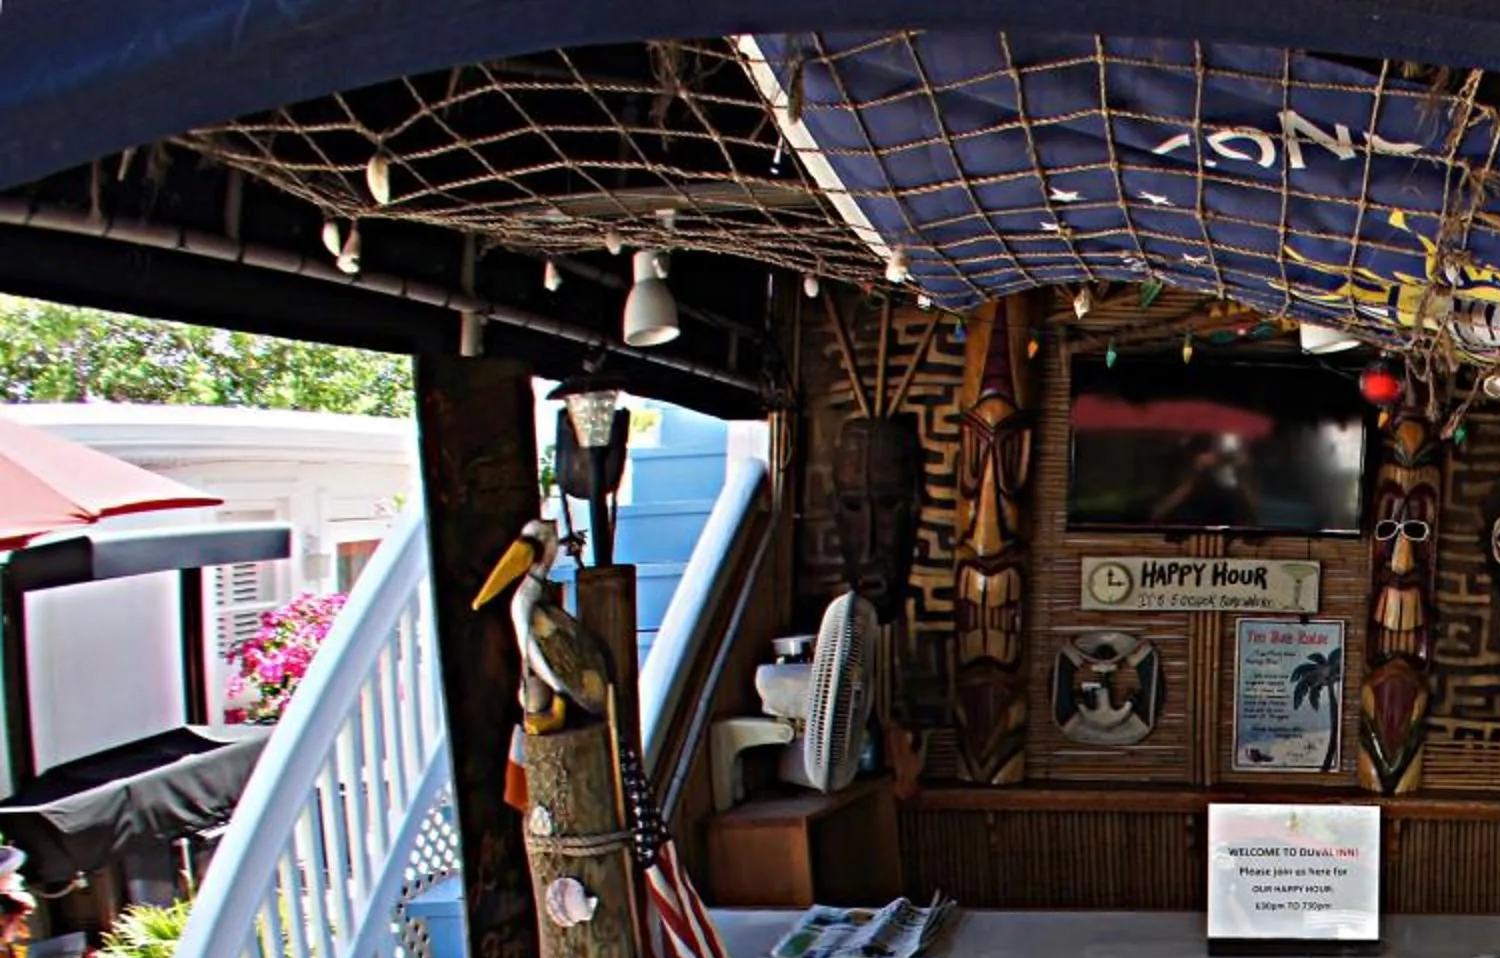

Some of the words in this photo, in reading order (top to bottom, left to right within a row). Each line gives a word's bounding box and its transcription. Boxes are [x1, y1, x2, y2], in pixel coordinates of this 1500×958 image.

[1140, 560, 1206, 588] HAPPY
[1212, 561, 1268, 590] HOUR
[1228, 848, 1280, 857] WELCOME
[1284, 848, 1296, 857] TO
[1300, 848, 1333, 857] DUVAL
[1336, 848, 1359, 857] INN!
[1239, 867, 1271, 876] Please
[1272, 867, 1293, 878] join
[1308, 867, 1332, 876] here
[1333, 867, 1347, 876] for
[1252, 885, 1272, 893] OUR
[1274, 885, 1304, 893] HAPPY
[1305, 885, 1333, 893] HOUR
[1287, 901, 1300, 910] TO
